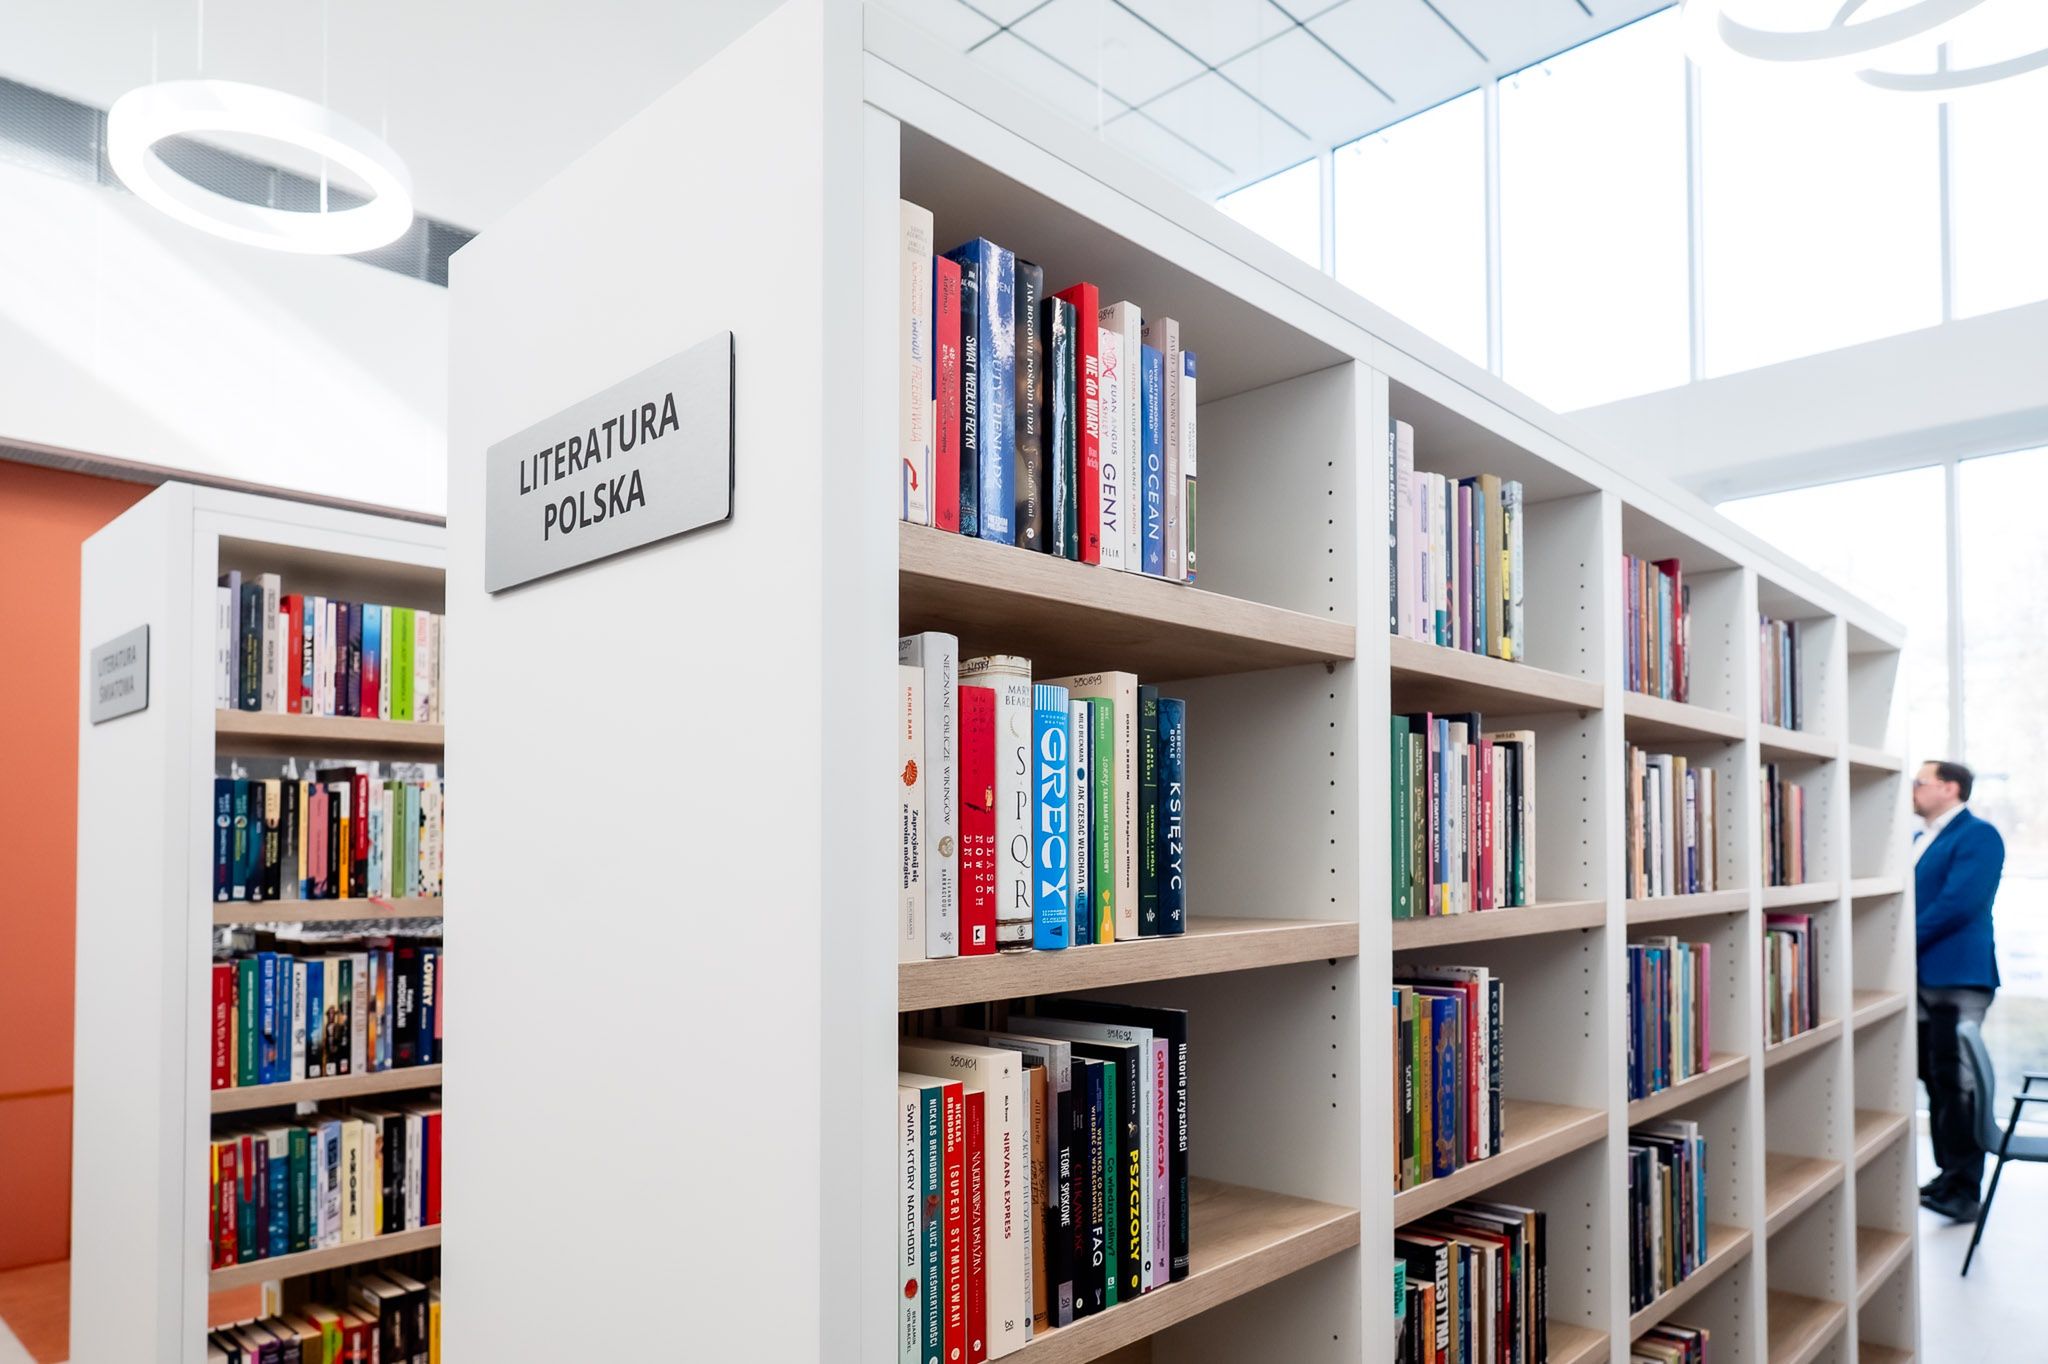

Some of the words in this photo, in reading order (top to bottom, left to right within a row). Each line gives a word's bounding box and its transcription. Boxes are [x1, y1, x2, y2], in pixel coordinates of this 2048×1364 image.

[1026, 282, 1035, 302] JAK
[1026, 305, 1035, 357] BOGOWIE
[1026, 357, 1036, 400] POŚRÓD
[1085, 354, 1098, 376] NIE
[1086, 377, 1098, 396] do
[965, 371, 976, 415] WEDŁUG
[1110, 384, 1118, 413] EUAN
[965, 416, 976, 450] FIZYKI
[1026, 402, 1034, 435] LUDZI
[1086, 398, 1099, 437] WIARY
[1101, 398, 1109, 437] ASHLEY
[520, 392, 680, 496] LITERATURA
[1027, 461, 1036, 491] Guido
[1148, 453, 1160, 540] OCEAN
[544, 469, 646, 541] POLSKA
[1027, 491, 1036, 517] Alfani
[1102, 463, 1116, 533] GENY
[942, 653, 951, 712] NIEZNANE
[1007, 685, 1030, 695] MARY
[942, 714, 951, 762] OBLICZE
[903, 803, 909, 813] ze
[942, 766, 953, 825] WIKINGÓW
[1077, 784, 1085, 801] JAK
[911, 809, 920, 868] Zaprzyjaźnij
[1041, 727, 1067, 908] GRECY
[1077, 802, 1086, 836] CZESAĆ
[1168, 782, 1183, 890] KSIĘŻYC
[902, 846, 911, 889] mózgiem
[963, 834, 972, 869] DNI
[975, 834, 984, 906] NOWYCH
[986, 835, 994, 895] BLASK
[1076, 837, 1086, 885] WŁOCHATĄ
[911, 869, 920, 883] się
[422, 953, 435, 1006] LOWRY
[1178, 1043, 1188, 1087] Historie
[906, 1103, 916, 1146] ŚWIAT,
[929, 1098, 937, 1136] NICKLAS
[1177, 1089, 1189, 1152] przyszłości
[907, 1149, 917, 1191] KTÓRY
[929, 1139, 937, 1191] BRENDBORG
[1060, 1146, 1070, 1179] TEORIE
[1097, 1176, 1103, 1189] CO
[1107, 1157, 1115, 1173] Co
[949, 1164, 961, 1221] (SUPER)
[1060, 1182, 1071, 1228] SPISKOWE
[1106, 1175, 1115, 1215] wiedzą
[1129, 1149, 1140, 1261] PSZCZOŁY
[1179, 1177, 1187, 1202] David
[907, 1194, 915, 1267] NADCHODZI
[929, 1220, 937, 1248] KLUCZ
[1106, 1216, 1116, 1257] rośliny?
[1179, 1203, 1187, 1244] Christian
[929, 1251, 937, 1263] DO
[1092, 1226, 1103, 1267] FAQ
[949, 1227, 961, 1328] STYMULOWANI
[1435, 1246, 1449, 1351] PALESTYNA
[929, 1265, 939, 1347] NIEŚMIERTELNOŚCI
